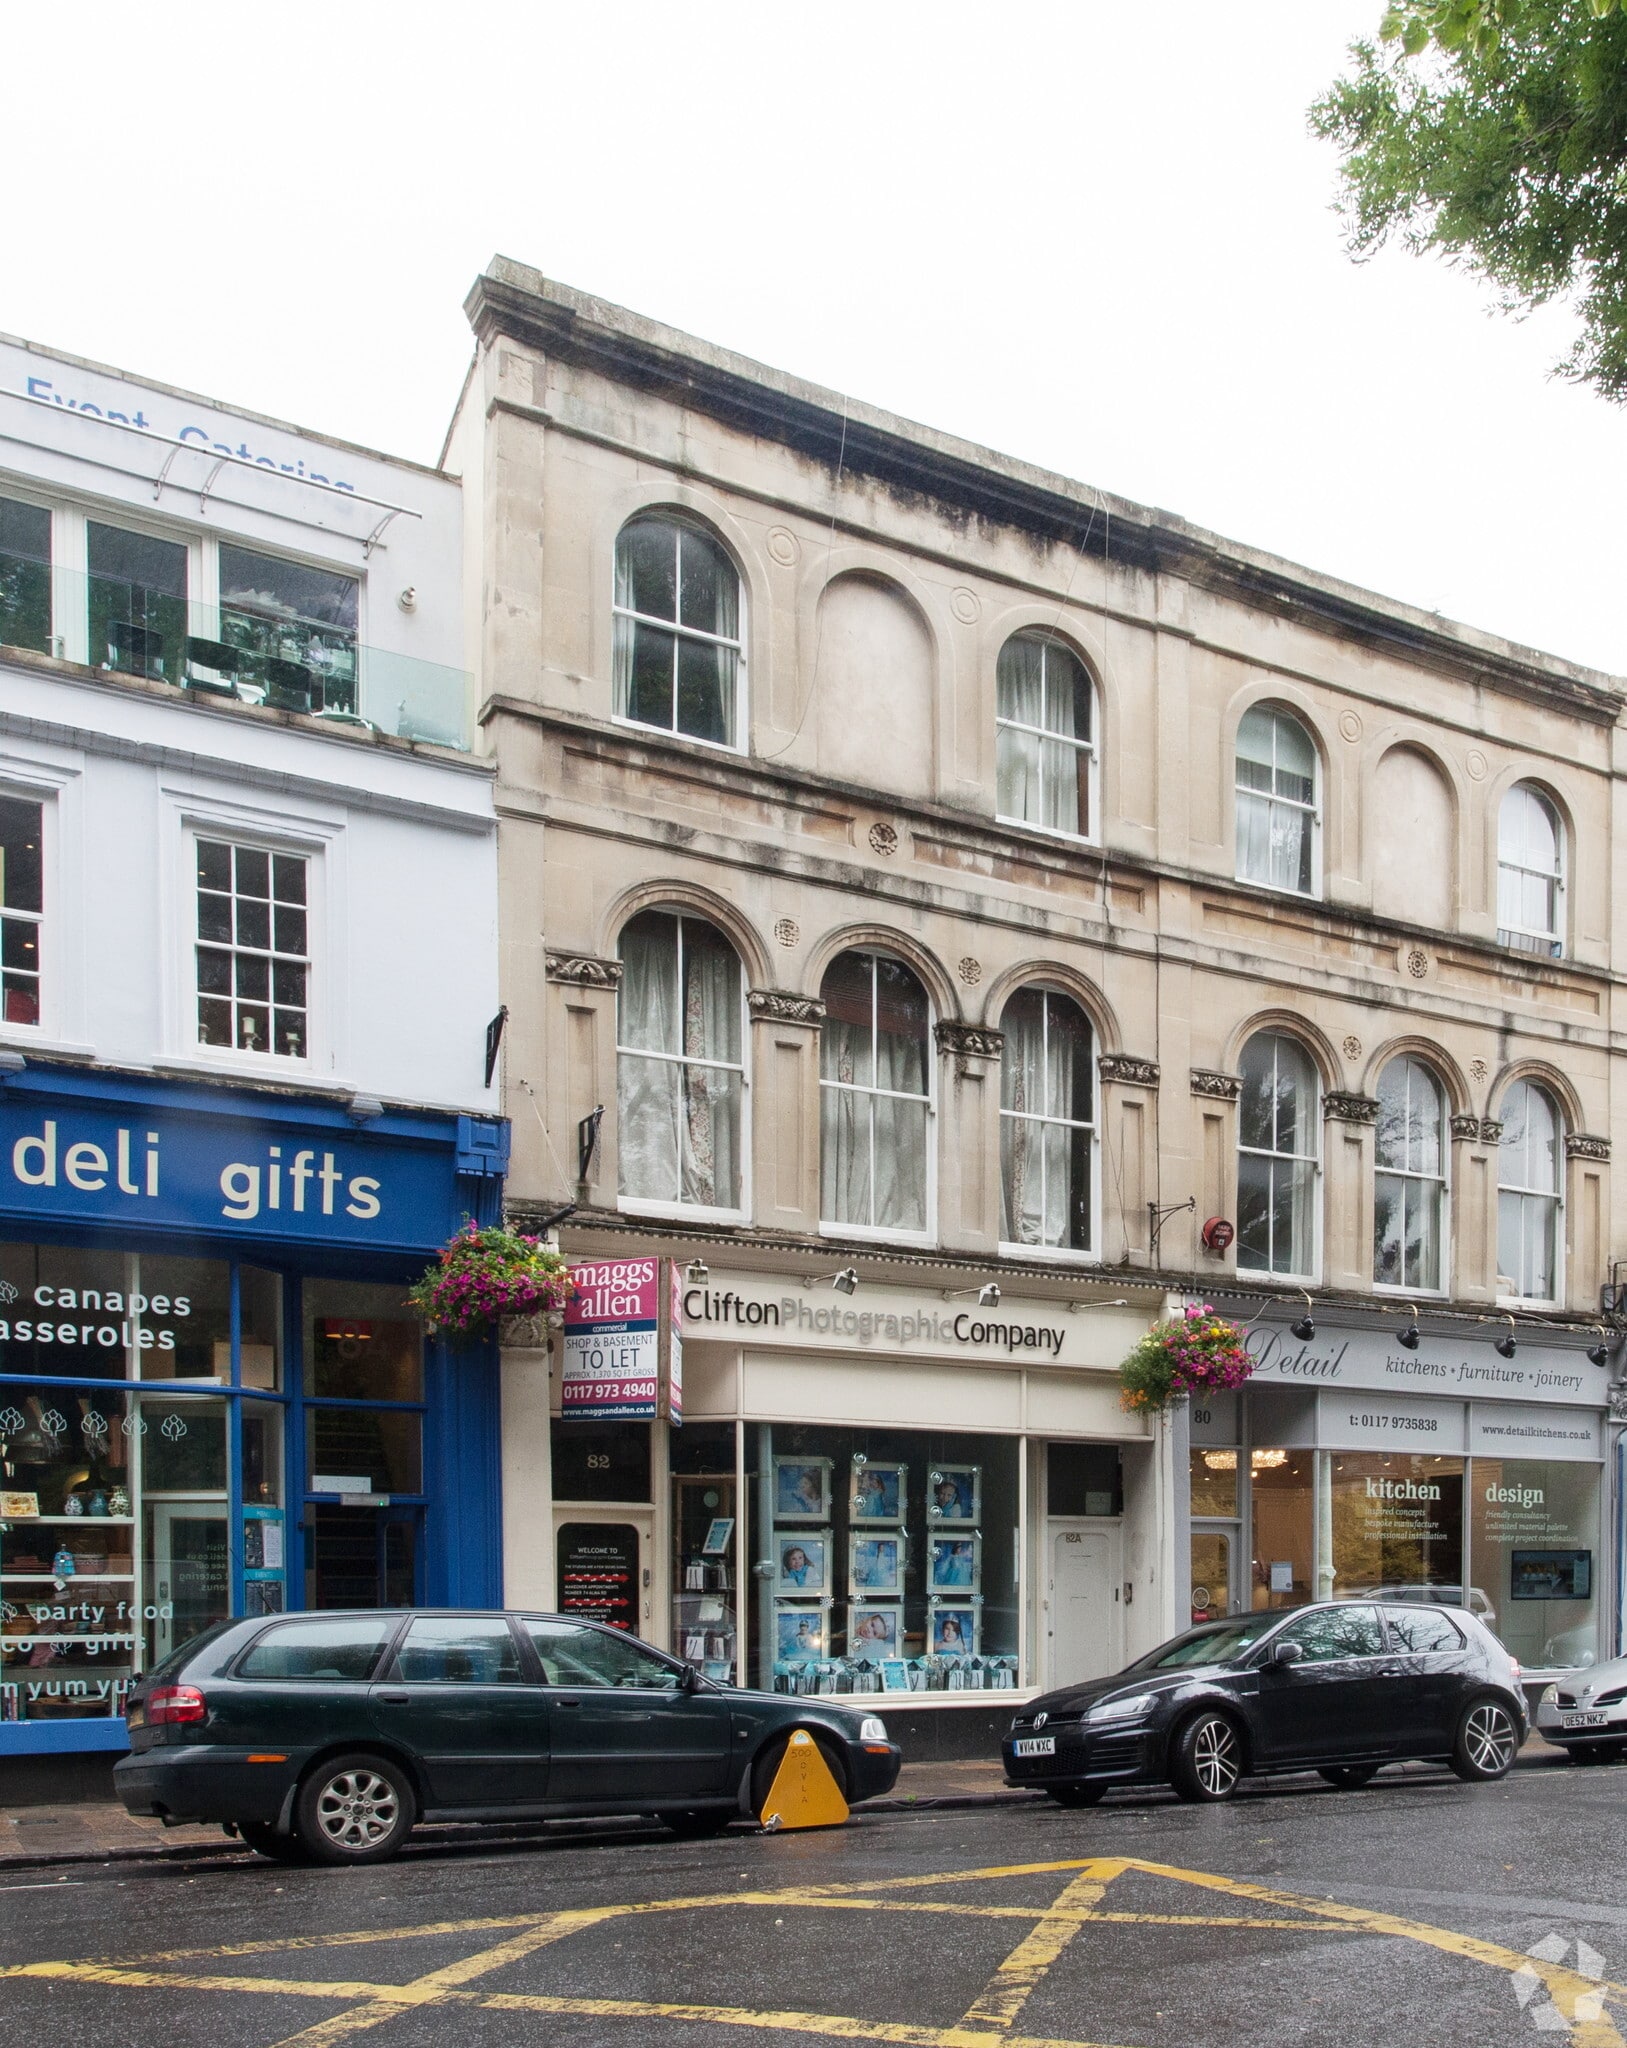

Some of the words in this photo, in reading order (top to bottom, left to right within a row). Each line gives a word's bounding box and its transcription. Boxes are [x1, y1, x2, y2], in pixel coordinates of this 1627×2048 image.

[13, 1120, 159, 1197] deli
[220, 1146, 381, 1220] gifts
[573, 1261, 654, 1292] maggs
[34, 1285, 191, 1318] canapes
[581, 1288, 642, 1318] allen
[592, 1322, 628, 1333] commercial
[566, 1338, 591, 1349] SHOP
[593, 1337, 601, 1348] &
[603, 1334, 653, 1347] BASEMENT
[579, 1350, 604, 1370] TO
[611, 1348, 640, 1368] LET
[1244, 1327, 1350, 1378] Detail
[564, 1371, 591, 1379] APPROX
[592, 1370, 611, 1379] 1,370
[613, 1369, 622, 1378] SQ
[623, 1369, 631, 1377] FT
[632, 1368, 655, 1377] GROSS
[1386, 1356, 1447, 1377] kitchens
[1457, 1362, 1524, 1383] furniture
[1534, 1369, 1584, 1391] joinery
[564, 1385, 593, 1399] 0117
[595, 1383, 619, 1398] 973
[622, 1382, 655, 1397] 4940
[563, 1405, 655, 1417] www.maggsandallen.co.uk
[1194, 1409, 1211, 1424] 80
[1350, 1414, 1358, 1426] t:
[1361, 1414, 1388, 1428] 0117
[1392, 1416, 1438, 1431] 9735838
[1482, 1424, 1591, 1440] www.detailkitchens.co.uk
[587, 1454, 610, 1469] 82
[1365, 1476, 1441, 1500] kitchen
[1485, 1482, 1544, 1509] design
[1365, 1507, 1394, 1517] inspired
[1395, 1508, 1426, 1518] concepts
[1485, 1510, 1512, 1520] friendly
[1512, 1511, 1551, 1521] consultancy
[1364, 1519, 1392, 1528] bespoke
[1393, 1520, 1439, 1530] manufacture
[1485, 1521, 1517, 1530] unlimited
[1519, 1523, 1545, 1531] material
[1065, 1533, 1082, 1543] 82A
[1364, 1531, 1407, 1540] professional
[1408, 1531, 1448, 1540] installation
[1485, 1533, 1515, 1543] complete
[1515, 1534, 1538, 1543] project
[1538, 1534, 1579, 1542] coordination
[36, 1602, 104, 1624] party
[116, 1601, 174, 1620] food
[85, 1633, 147, 1656] gifts
[28, 1679, 87, 1701] yum
[97, 1679, 137, 1701] yu
[1587, 1713, 1604, 1725] NKZ
[791, 1749, 812, 1759] 500
